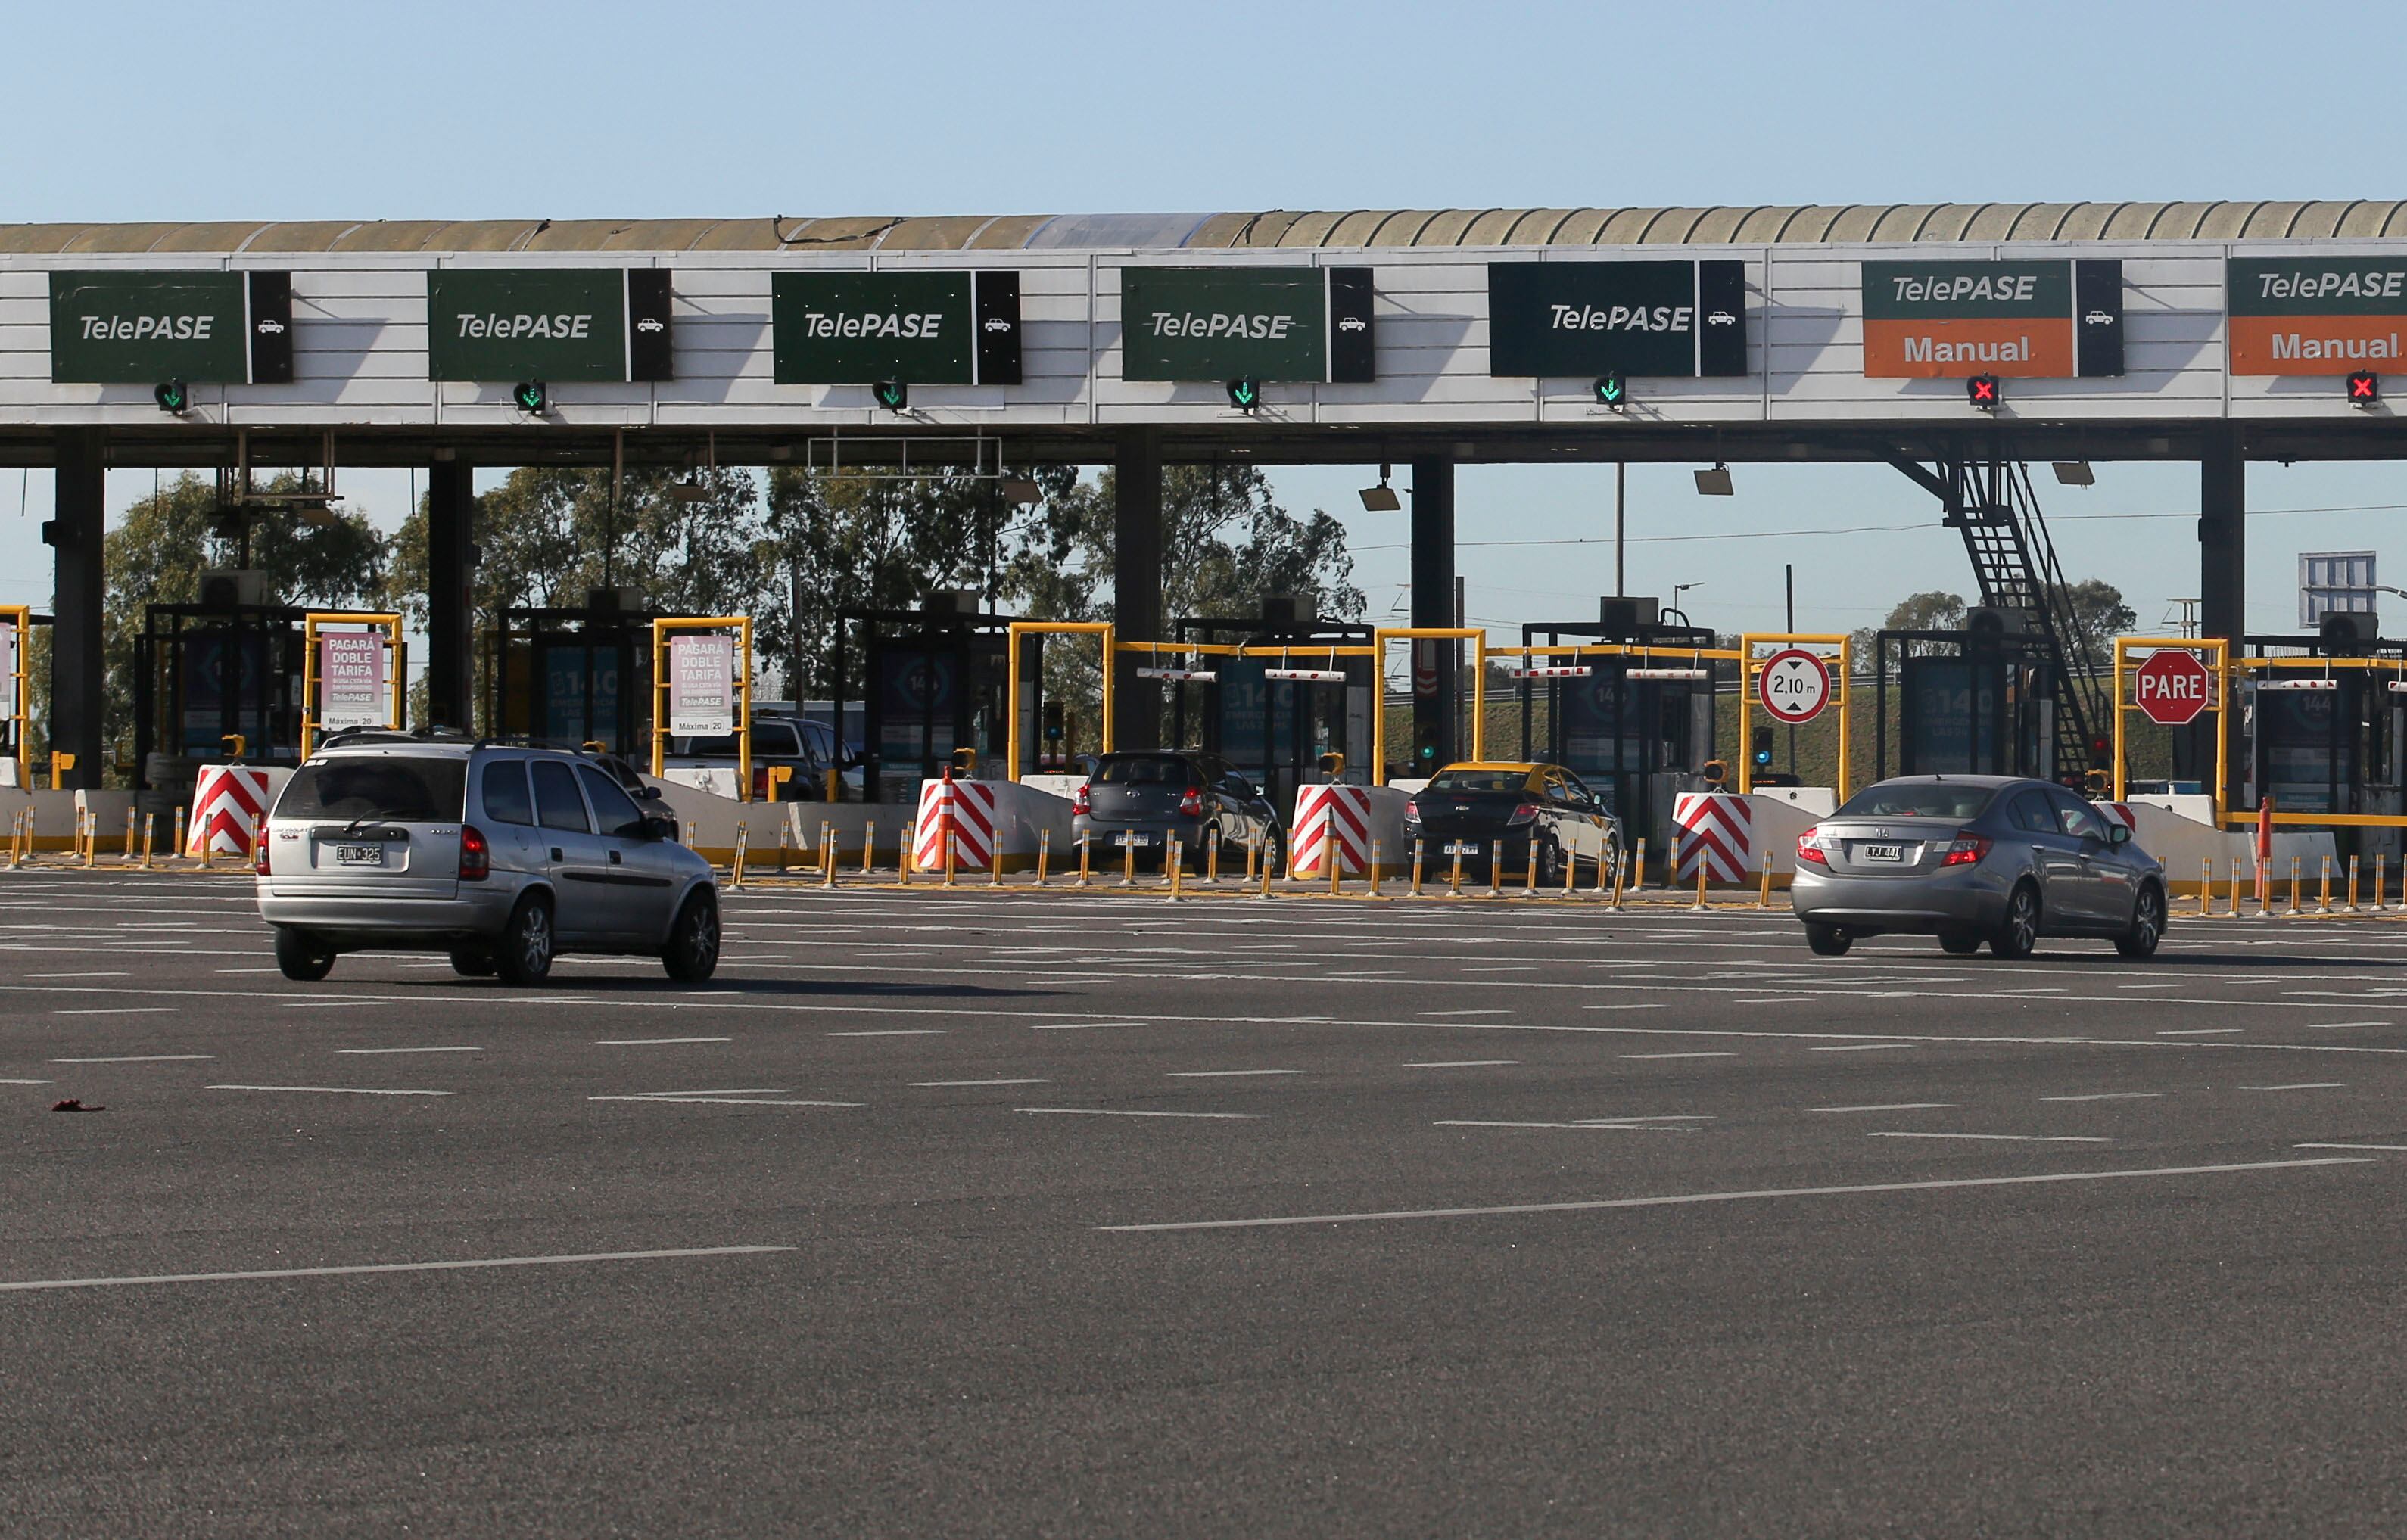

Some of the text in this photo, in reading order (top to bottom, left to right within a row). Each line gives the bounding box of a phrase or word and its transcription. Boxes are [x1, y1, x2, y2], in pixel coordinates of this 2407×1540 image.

[1893, 276, 2037, 301] TelePASE
[2259, 272, 2405, 297] TelePASE
[457, 313, 592, 338] TelePASE
[805, 313, 942, 338] TelePASE
[1151, 312, 1291, 339] TelePASE
[1552, 304, 1693, 332] TelePASE
[81, 316, 214, 340] TelePASE
[1904, 337, 2029, 362] Manual
[2272, 332, 2398, 359] Manual
[329, 637, 375, 650] PAGARÁ
[678, 640, 724, 655] PAGARÁ
[333, 652, 372, 663] DOBLE
[681, 657, 721, 667] DOBLE
[332, 665, 373, 676] TARIFA
[680, 670, 722, 680] TARIFA
[1807, 686, 1816, 694] m
[2142, 675, 2202, 698] PARE
[332, 693, 372, 702] TelePASE
[682, 698, 722, 706] TelePASE
[338, 848, 380, 861] EUN 325
[1865, 847, 1900, 857] LYJ 441
